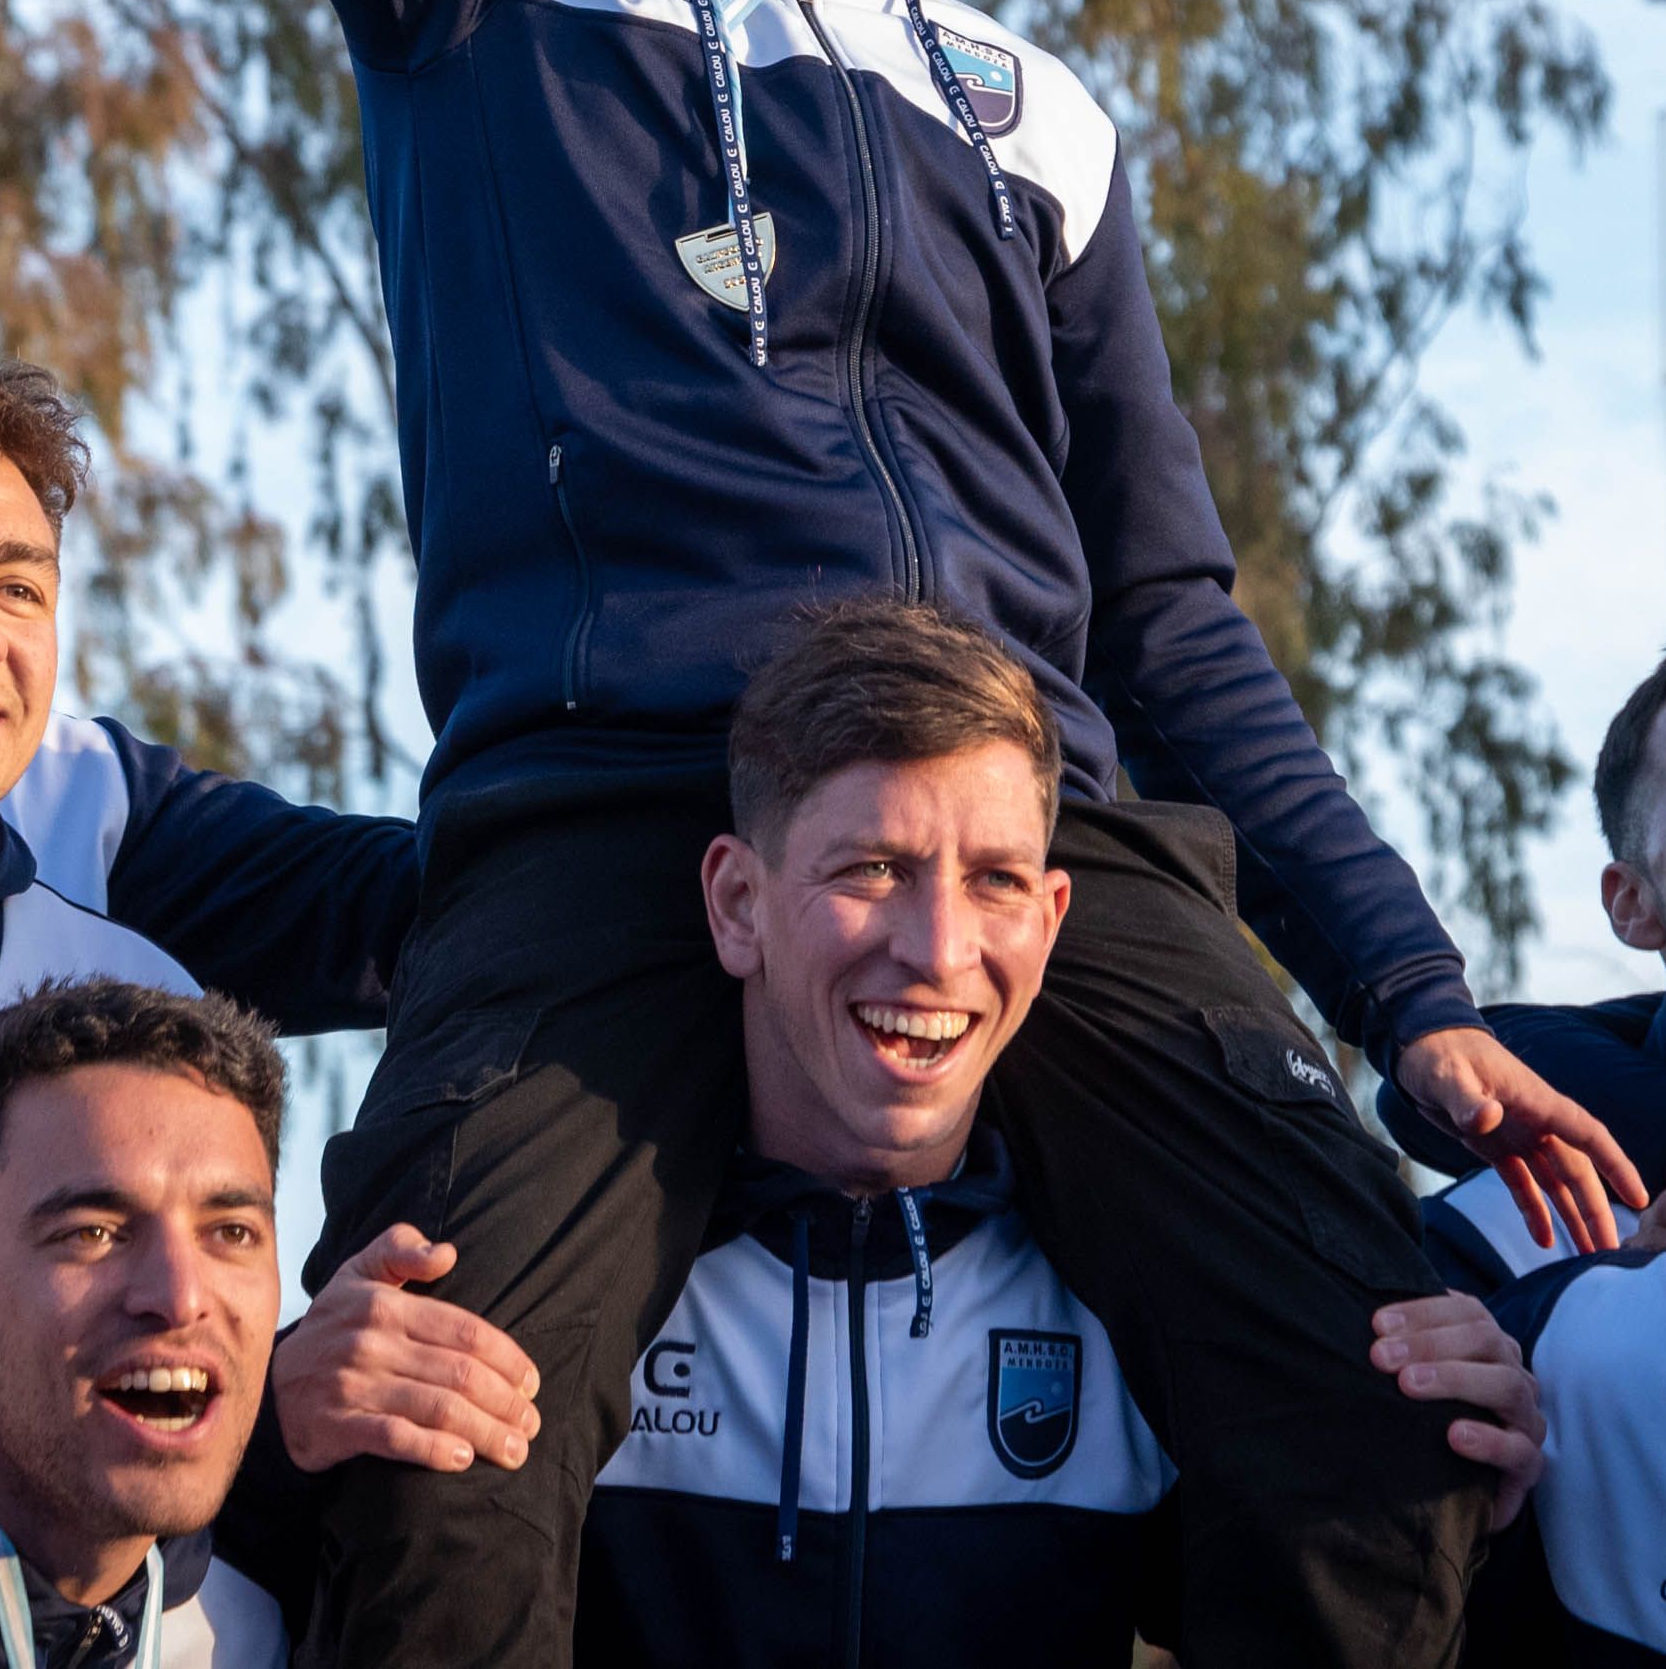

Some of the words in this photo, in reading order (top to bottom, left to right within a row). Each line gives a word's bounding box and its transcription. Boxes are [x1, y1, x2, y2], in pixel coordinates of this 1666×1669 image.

[701, 10, 716, 37] CALOU
[711, 55, 725, 88] CALOU
[910, 6, 926, 36] CALOU
[932, 51, 953, 83] CALOU
[956, 97, 978, 128] CALOU
[979, 144, 1000, 176] CALOU
[720, 108, 734, 142] CALOU
[730, 163, 745, 198] CALOU
[741, 219, 755, 256] CALOU
[751, 277, 763, 314] CALOU
[631, 1407, 720, 1436] ALOU
